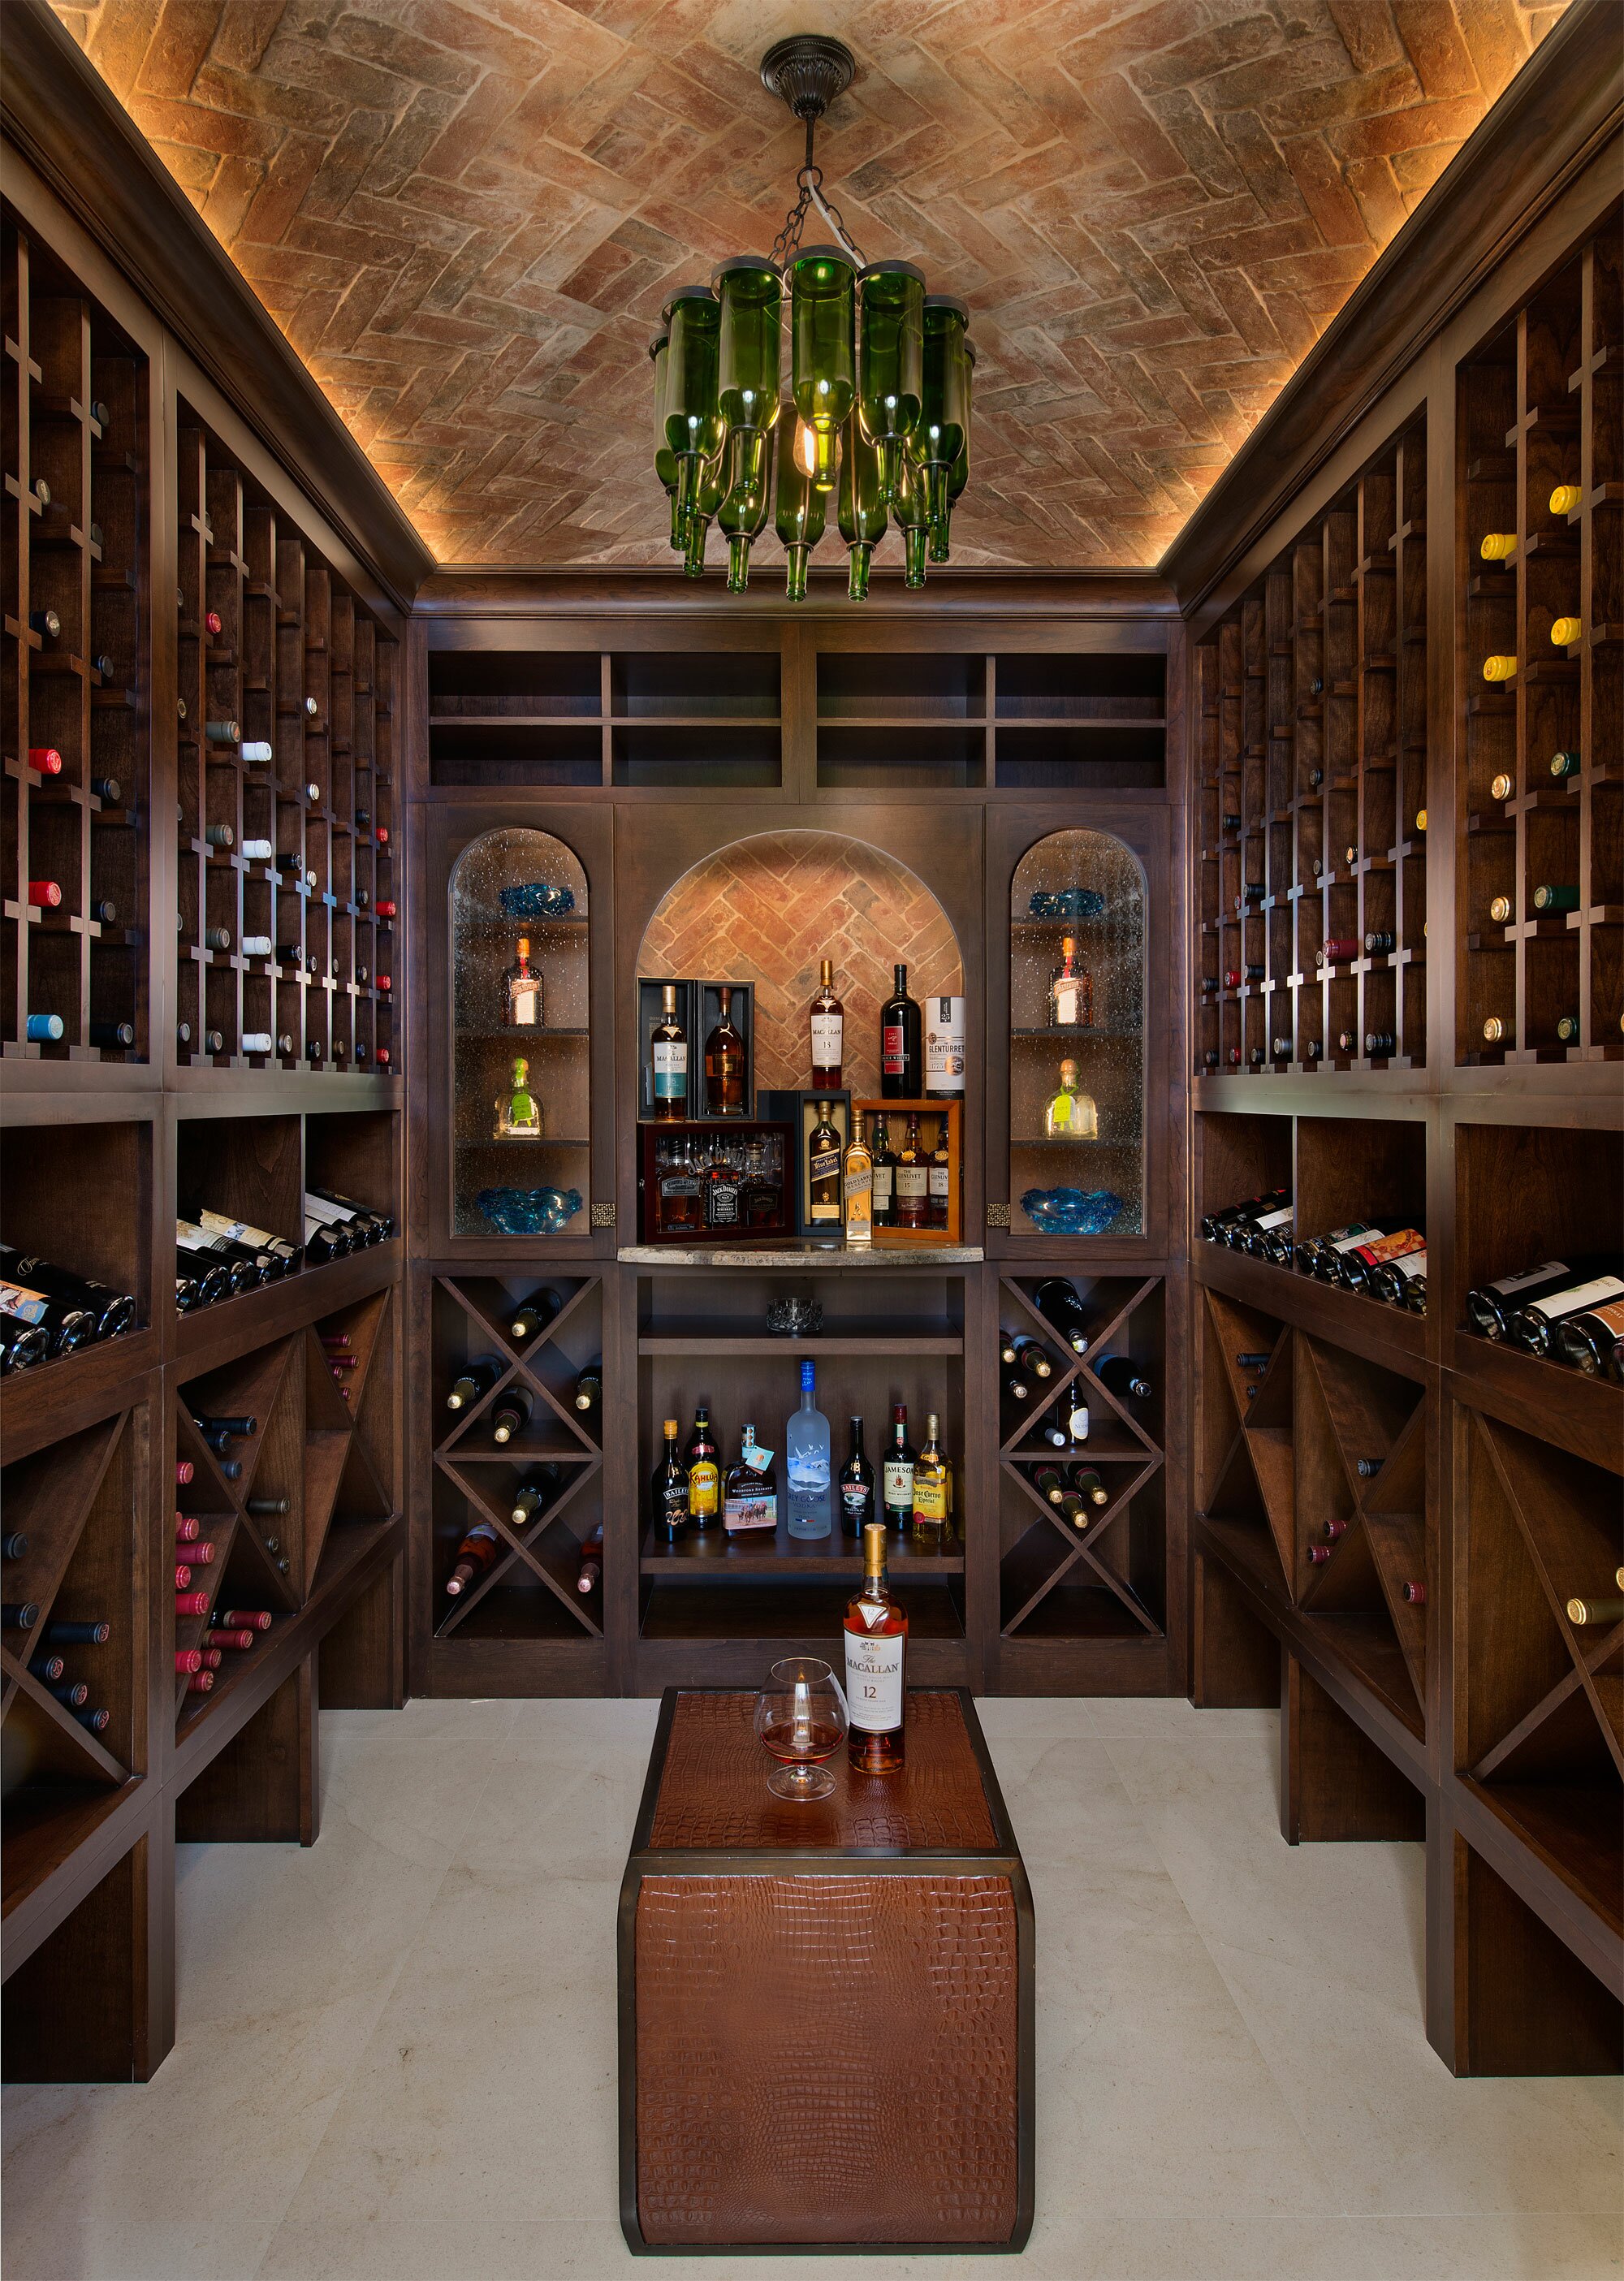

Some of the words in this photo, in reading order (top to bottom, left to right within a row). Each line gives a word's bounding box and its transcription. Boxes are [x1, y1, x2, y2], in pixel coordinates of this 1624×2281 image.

[929, 1044, 965, 1053] GLENTURRET
[814, 1160, 826, 1170] Blue
[825, 1156, 838, 1166] Label
[884, 1467, 914, 1475] JAMESON
[665, 1488, 689, 1497] BAILEY
[842, 1484, 868, 1493] BAILEYS
[924, 1490, 941, 1499] Cuervo
[862, 1654, 876, 1664] The
[846, 1657, 898, 1674] MACALLAN
[862, 1685, 877, 1699] 12
